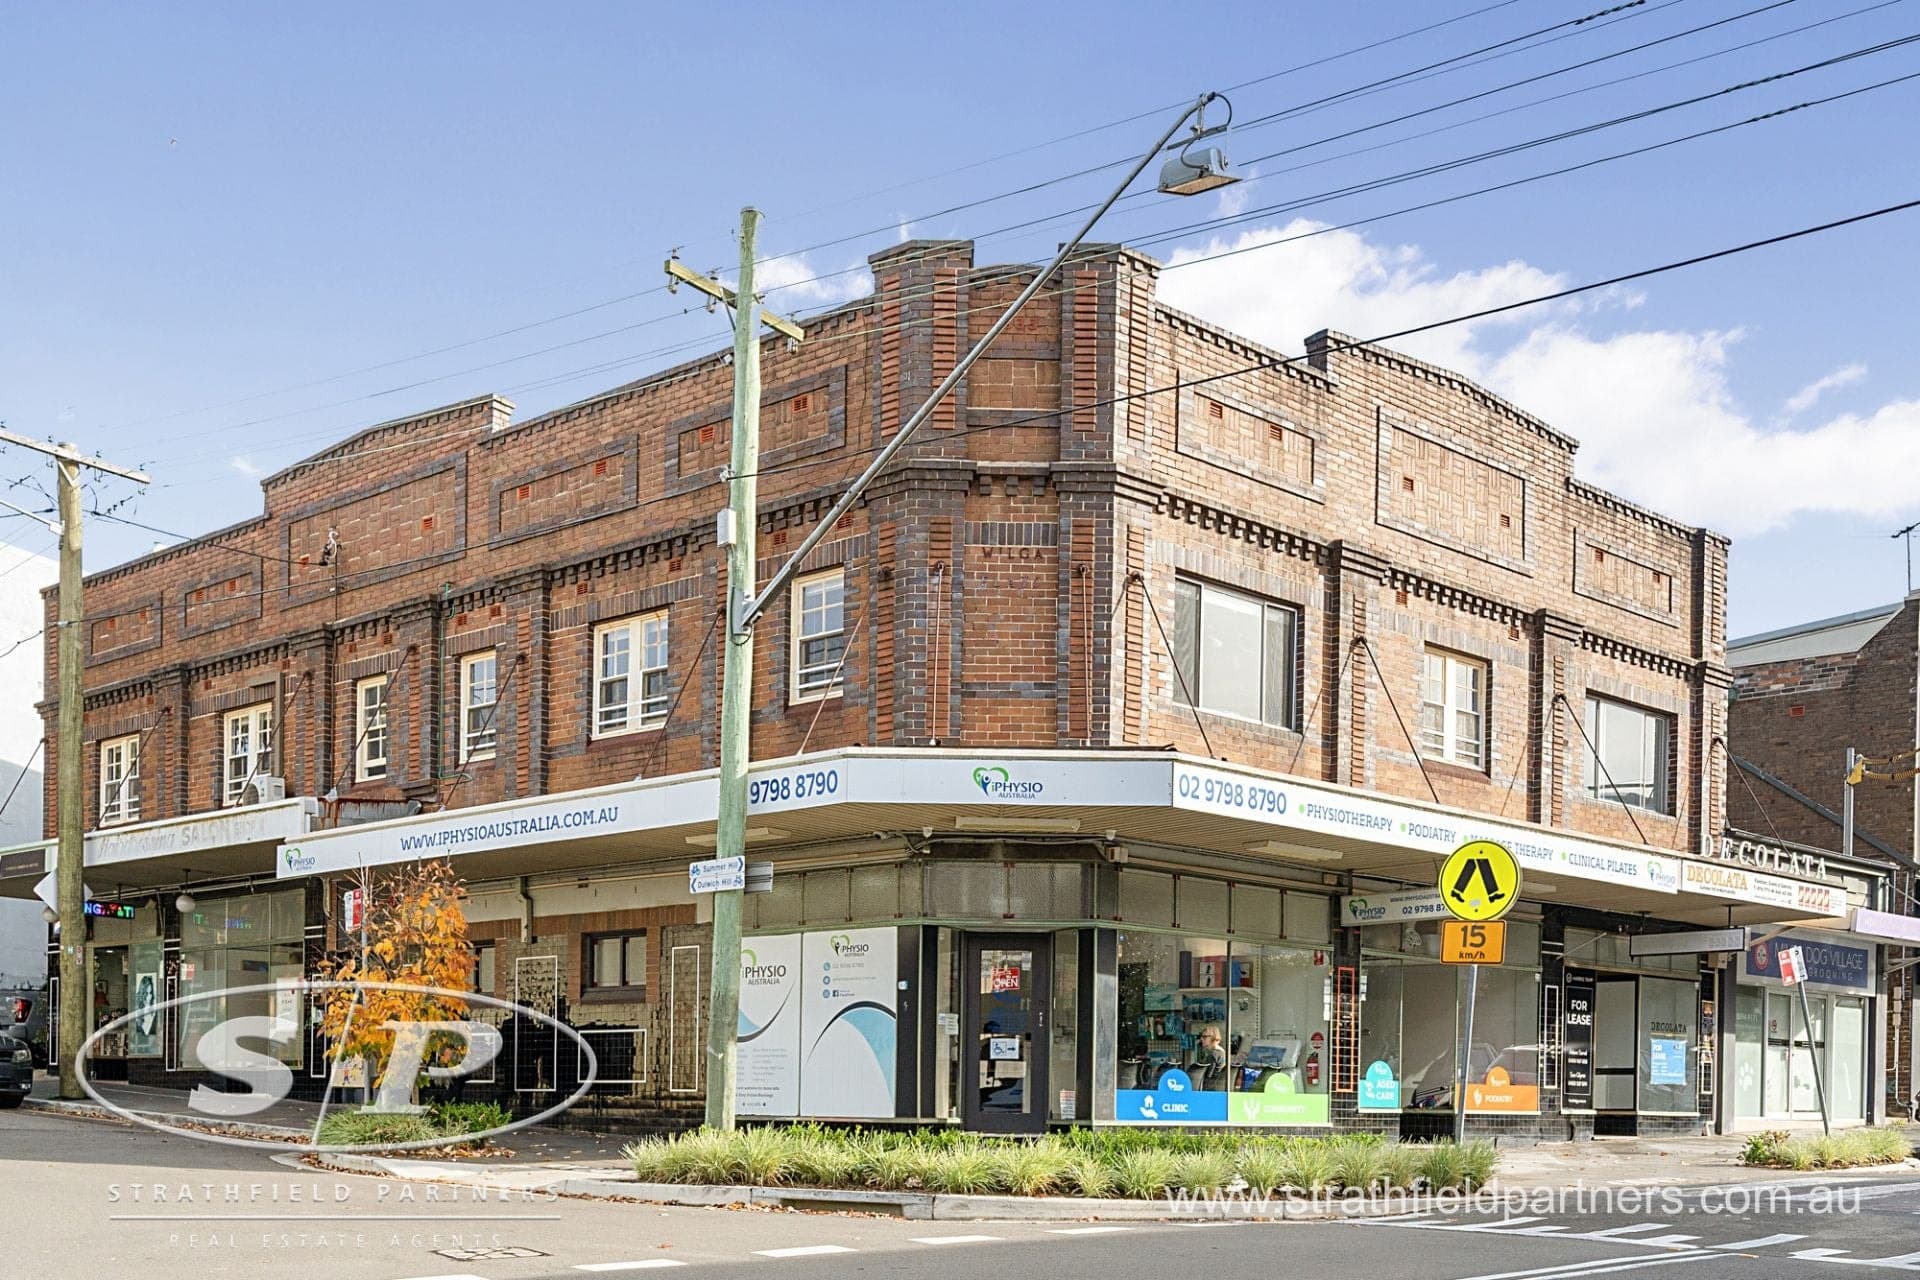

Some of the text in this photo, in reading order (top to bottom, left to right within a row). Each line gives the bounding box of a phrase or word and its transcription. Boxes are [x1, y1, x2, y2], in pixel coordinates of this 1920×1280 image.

[982, 546, 1045, 560] WILGA
[750, 769, 838, 804] 9798 8790
[998, 792, 1036, 800] AUSTRALIA
[400, 806, 619, 852] WWW.IPHYSIOAUSTRALIA.COM.AU
[1178, 774, 1200, 799] 02
[1205, 778, 1244, 807] 9798
[1248, 787, 1287, 815] 8790
[1307, 803, 1393, 832] PHYSIOTHERAPY
[1408, 823, 1457, 844] PODIATRY
[1514, 842, 1554, 861] THERAPY
[1568, 852, 1606, 870] CLINICAL
[1607, 860, 1637, 876] PILATES
[1700, 834, 1828, 880] DECOLATA
[703, 863, 726, 873] Summer
[1686, 865, 1748, 890] DECOLATA
[698, 879, 720, 889] Dulwich
[1402, 903, 1448, 915] 02 9798 87
[1461, 925, 1486, 948] 15
[1459, 951, 1485, 960] km/h
[1806, 947, 1828, 966] DOG
[1830, 951, 1864, 970] VILLAGE
[748, 978, 780, 986] AUSTRALIA
[993, 977, 1019, 988] OPEN
[1571, 999, 1588, 1011] FOR
[1567, 1013, 1592, 1026] LEASE
[1650, 1021, 1687, 1033] DECOLATA
[1376, 1080, 1396, 1089] AGED
[1376, 1091, 1395, 1101] CARE
[1162, 1103, 1189, 1113] CLINIC
